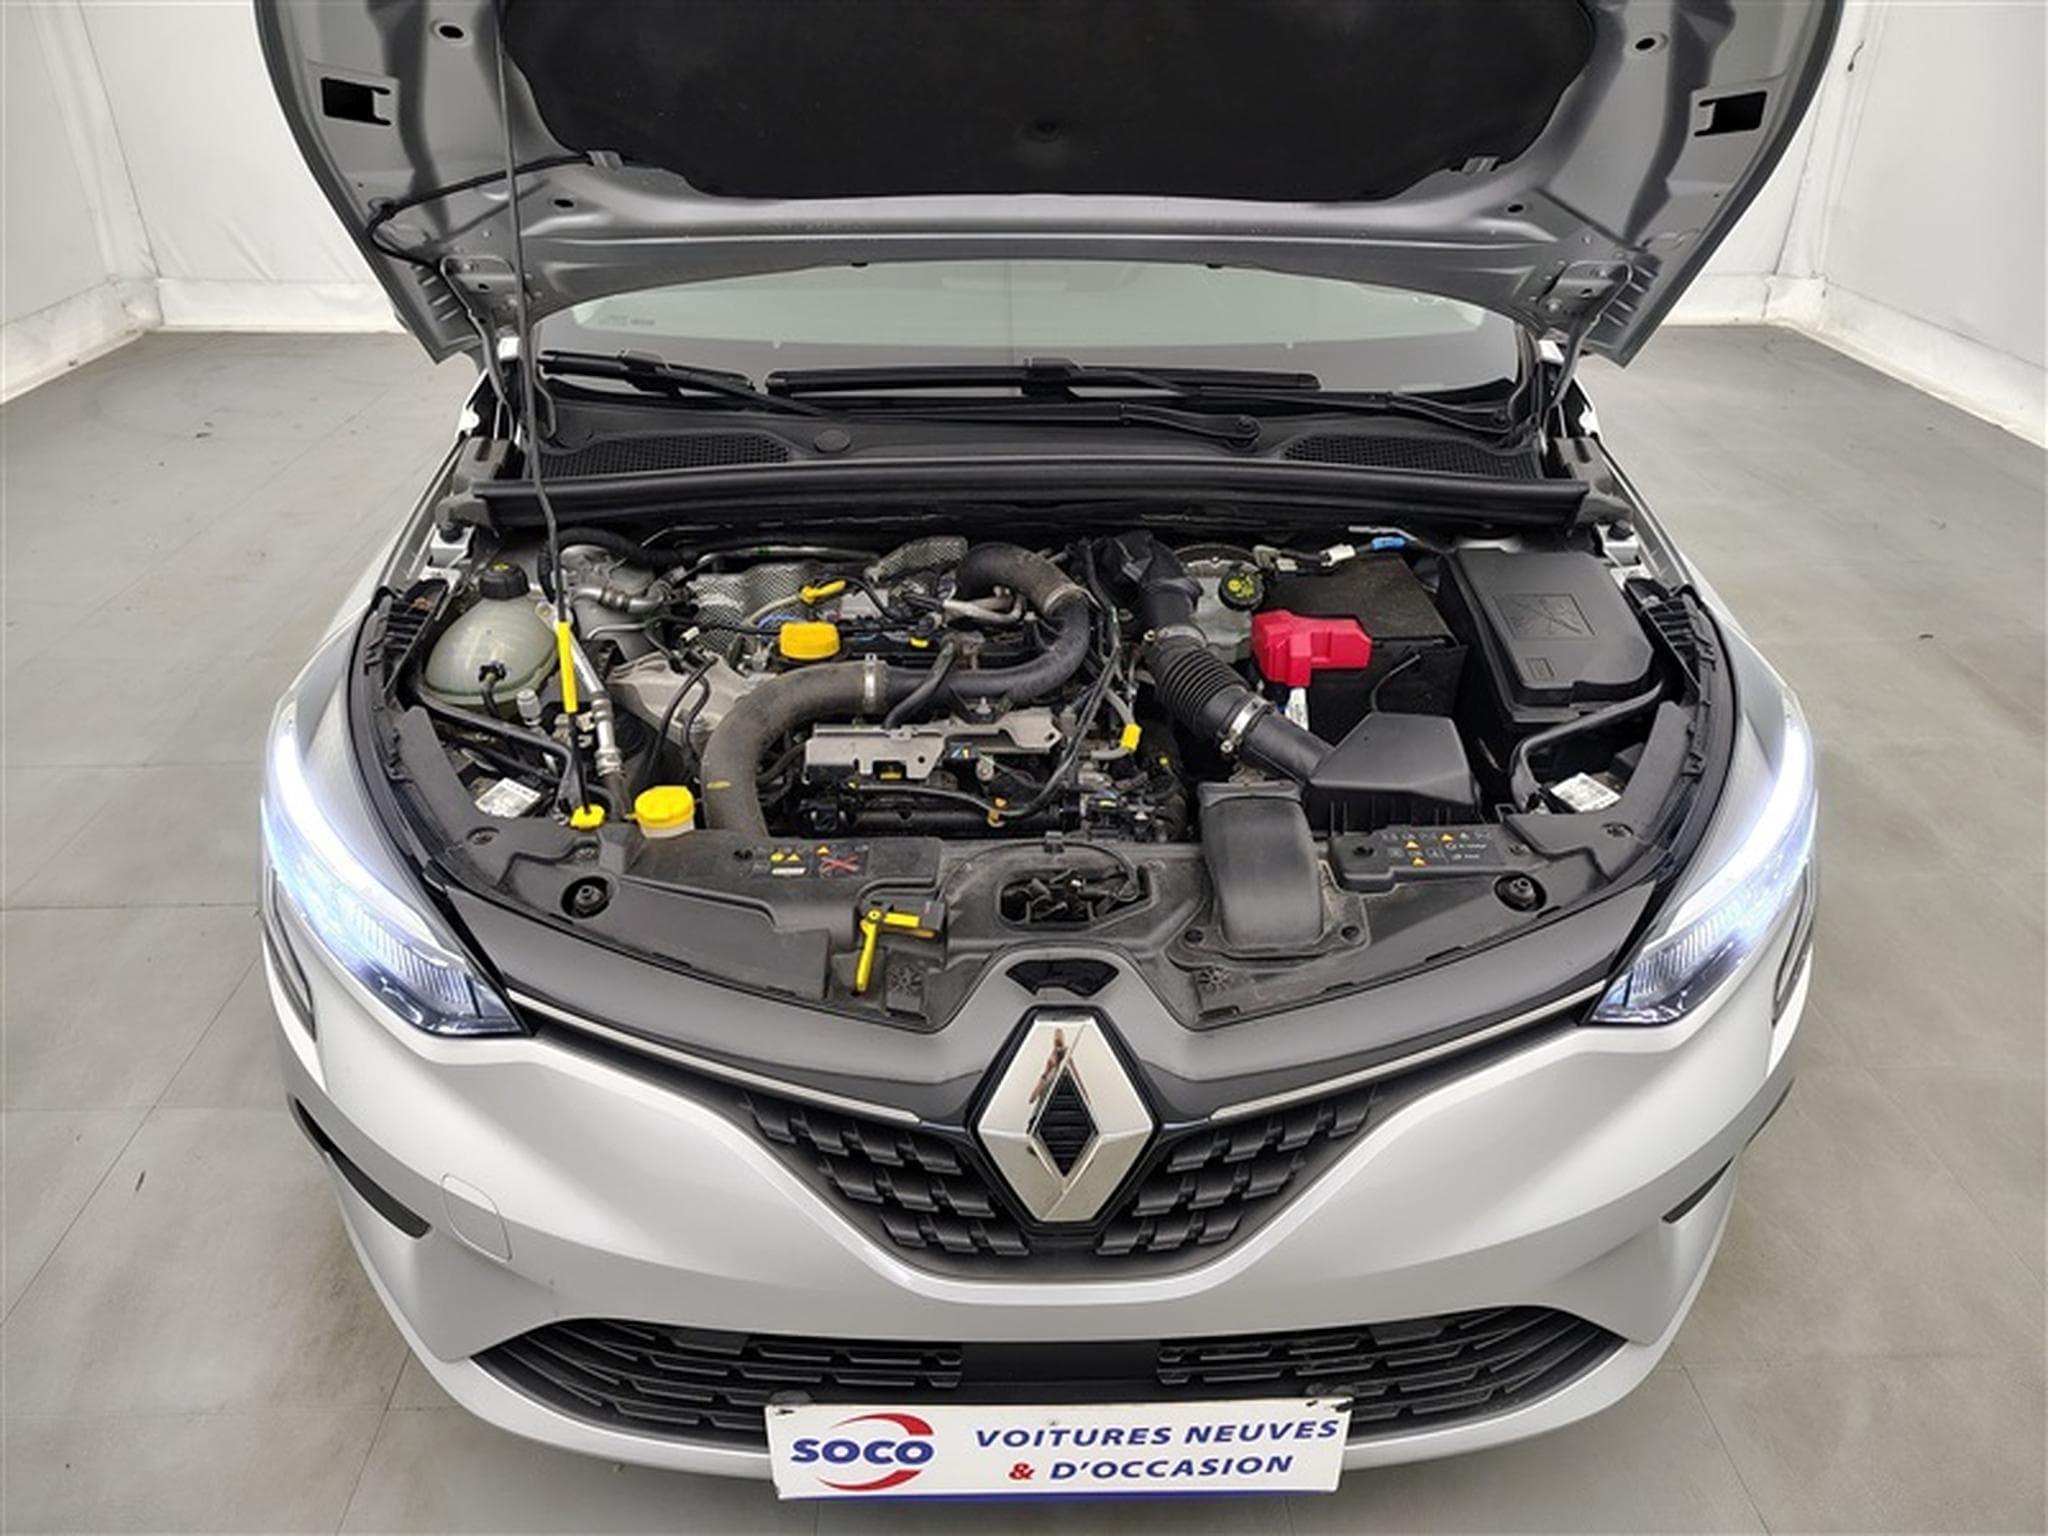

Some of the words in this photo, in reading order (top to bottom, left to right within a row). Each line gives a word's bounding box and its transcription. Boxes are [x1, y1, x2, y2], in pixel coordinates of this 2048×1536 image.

[976, 1427, 1172, 1447] VOITURES
[1184, 1420, 1339, 1444] NEUVES
[790, 1438, 934, 1465] SOCO
[1008, 1462, 1035, 1480] &
[1050, 1456, 1293, 1480] D'OCCASION
